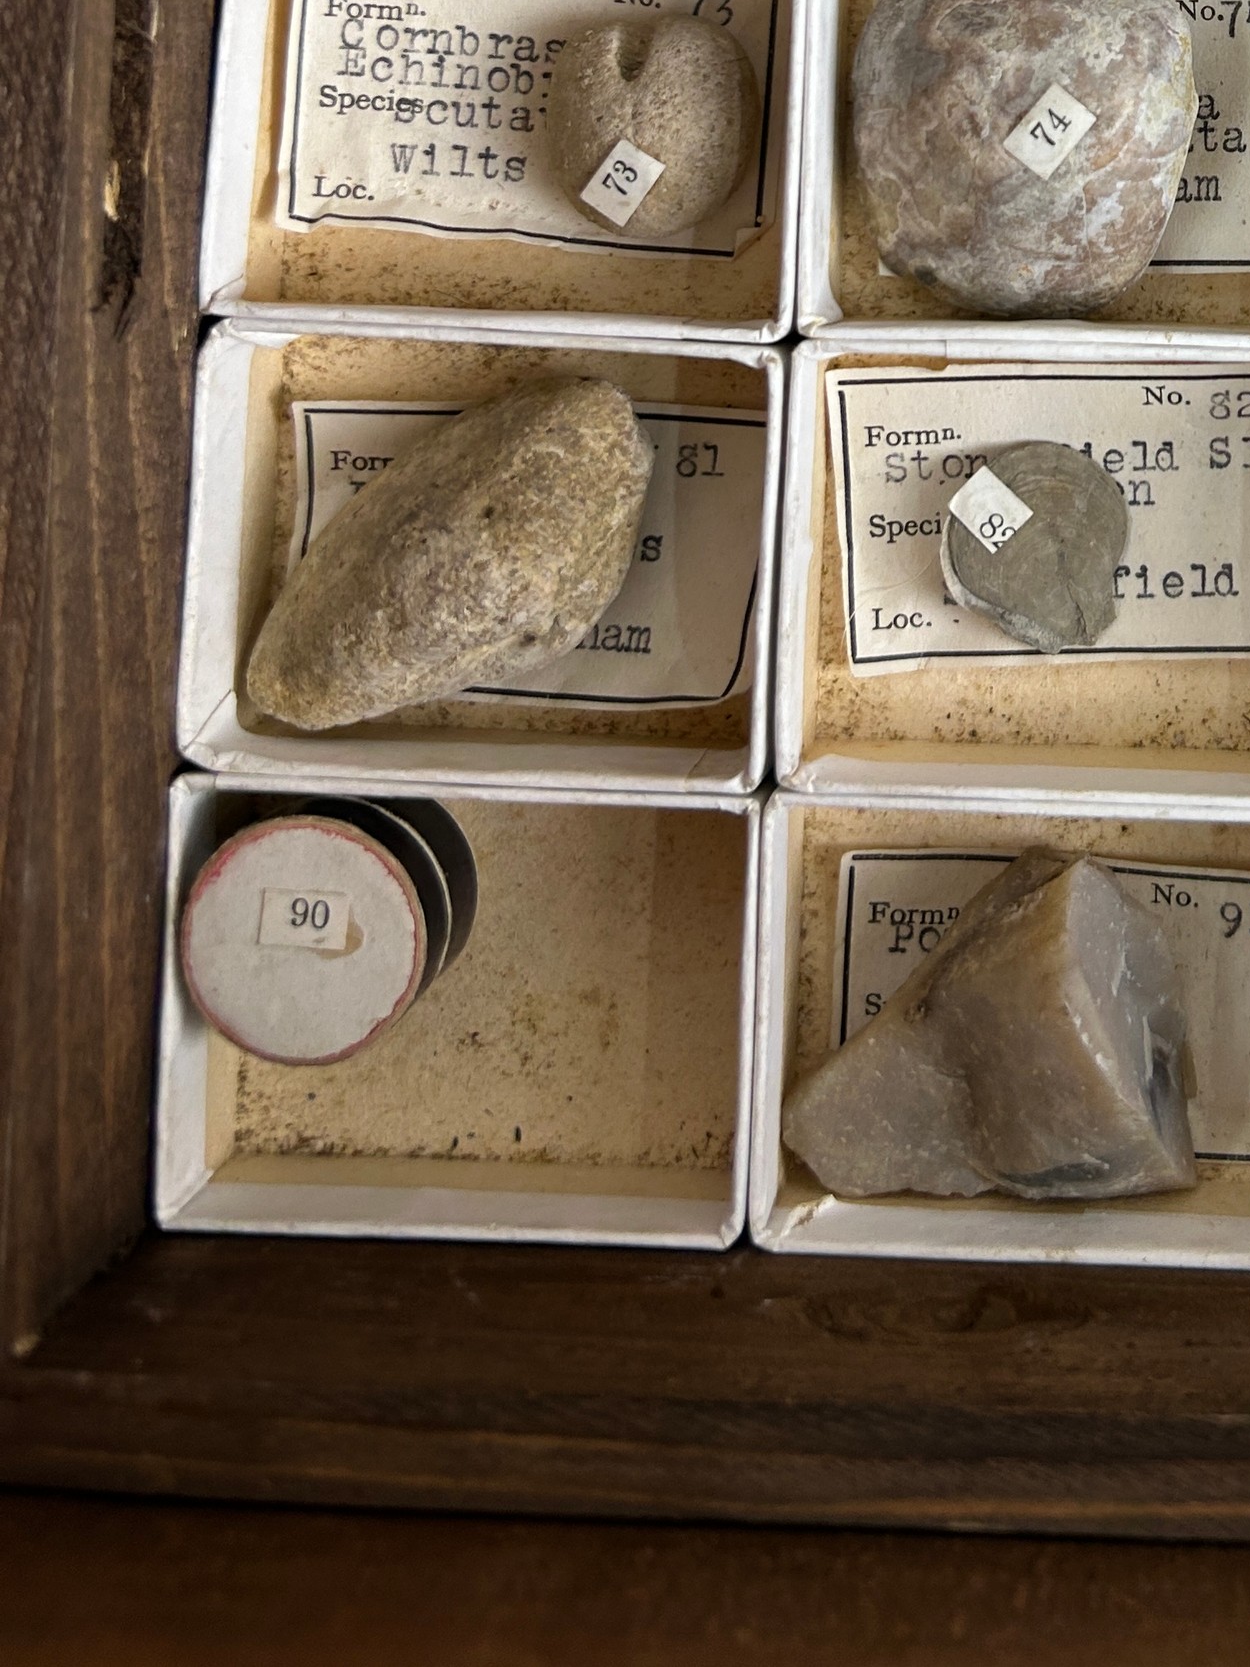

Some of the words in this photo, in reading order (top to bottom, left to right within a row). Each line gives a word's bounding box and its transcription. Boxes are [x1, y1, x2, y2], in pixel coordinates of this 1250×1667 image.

[339, 18, 568, 65] Cornbras
[1028, 107, 1074, 148] 74
[391, 142, 528, 182] Wilts
[602, 158, 640, 196] 73
[313, 175, 375, 202] Loc.
[1141, 385, 1192, 406] No.
[675, 442, 726, 478] 81
[869, 514, 943, 537] Speci
[872, 607, 932, 631] Loc.
[1151, 882, 1199, 909] No.
[290, 897, 331, 930] 90
